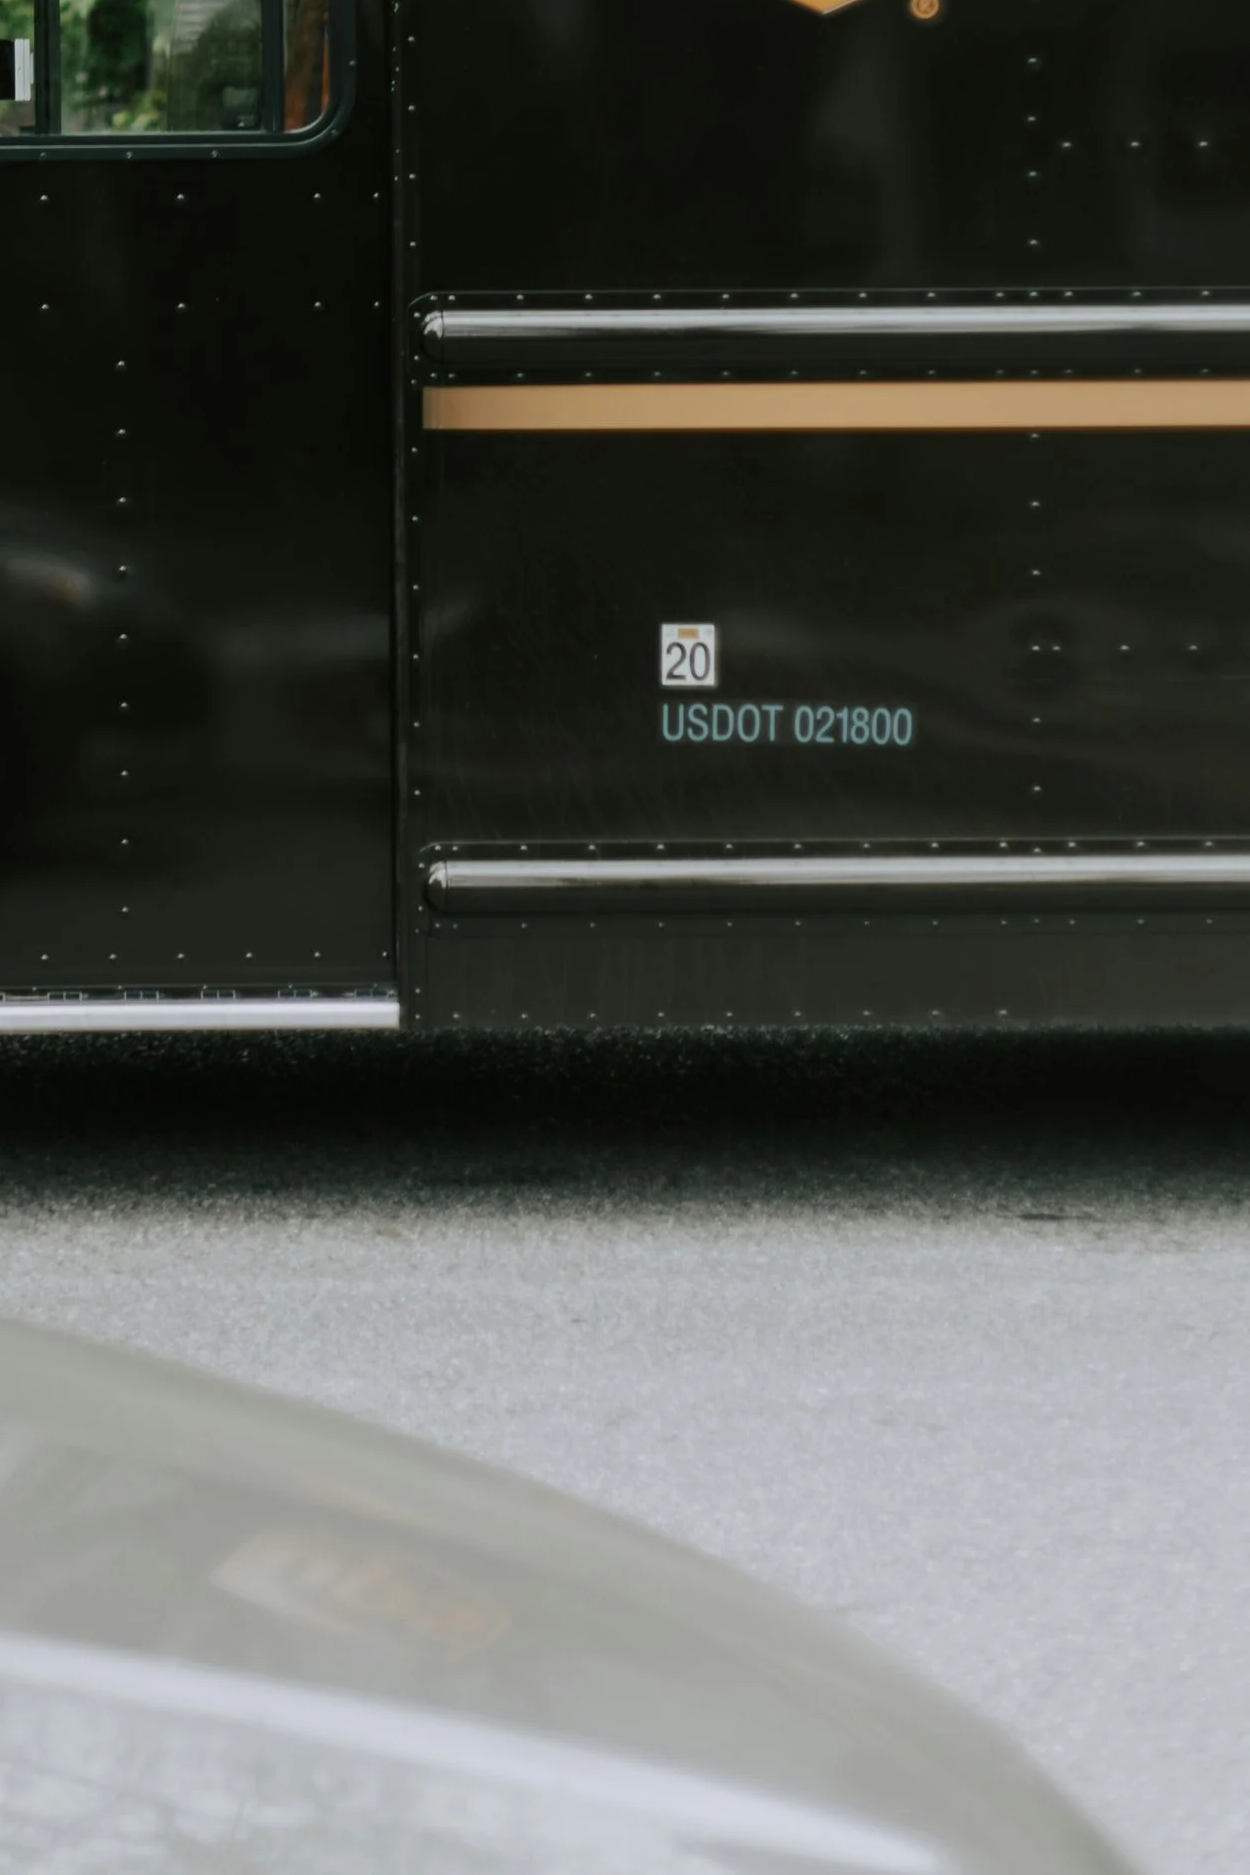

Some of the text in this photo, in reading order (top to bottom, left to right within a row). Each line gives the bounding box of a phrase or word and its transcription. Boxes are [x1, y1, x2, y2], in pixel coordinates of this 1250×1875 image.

[665, 641, 711, 682] 20
[662, 703, 913, 746] USDOT 021800
